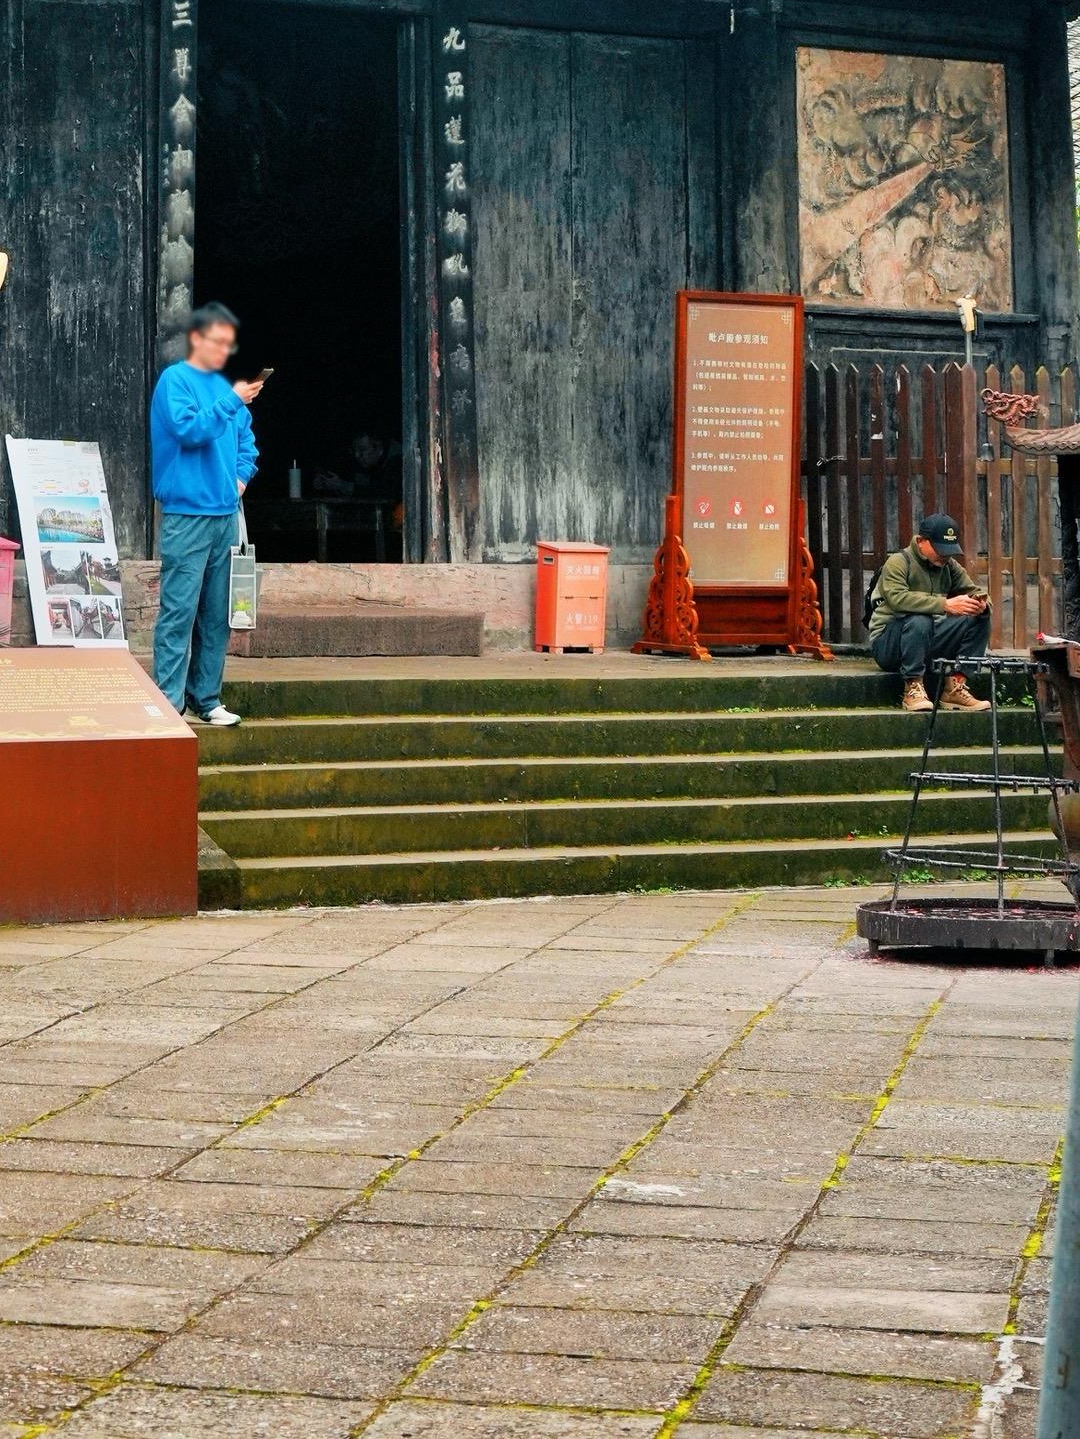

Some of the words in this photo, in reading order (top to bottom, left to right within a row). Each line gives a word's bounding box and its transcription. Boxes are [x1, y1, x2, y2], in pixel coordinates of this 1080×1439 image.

[708, 332, 768, 344] 毗卢殿参观须知
